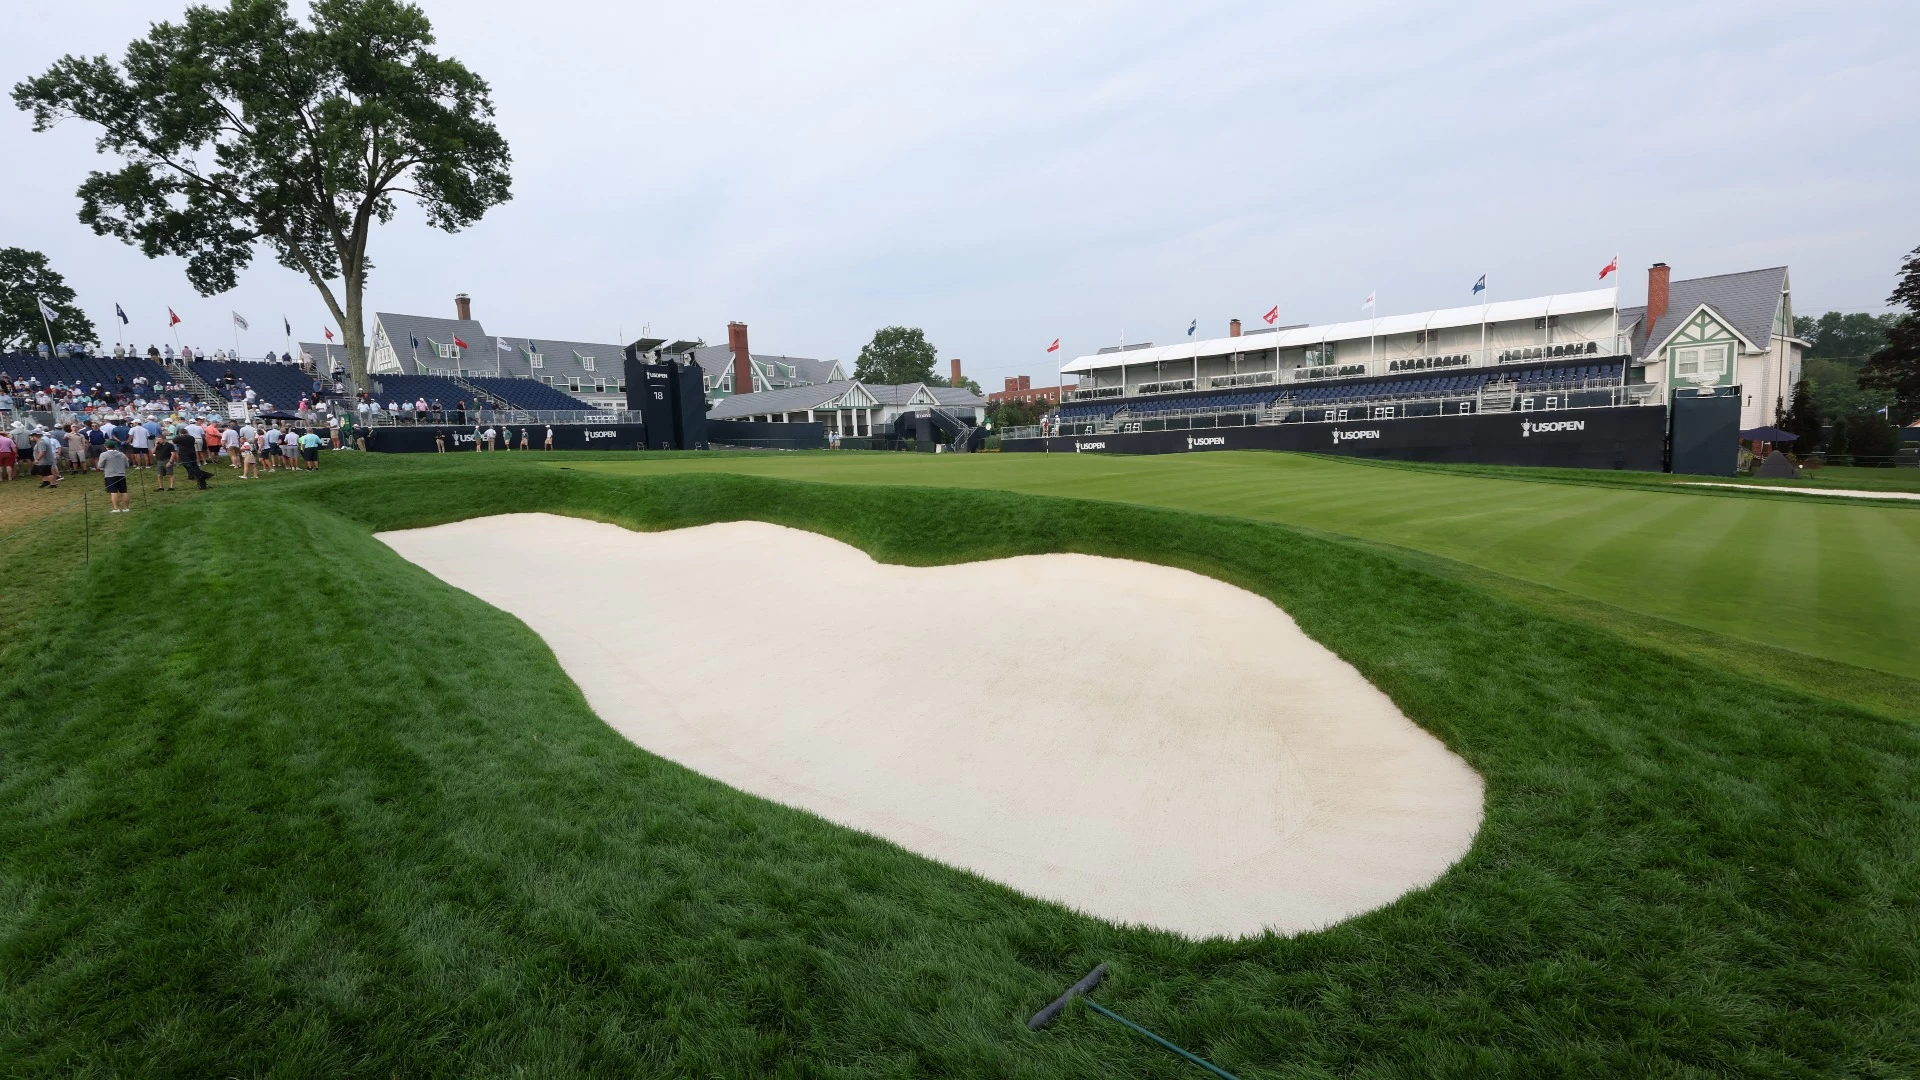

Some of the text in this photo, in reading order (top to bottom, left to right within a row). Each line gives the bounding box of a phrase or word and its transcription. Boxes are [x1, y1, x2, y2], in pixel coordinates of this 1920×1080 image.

[654, 391, 664, 400] 18
[1532, 420, 1585, 433] USOPEN
[590, 430, 617, 439] USOPEN
[1340, 430, 1380, 440] USOPEN
[1080, 441, 1106, 450] USOPEN
[1193, 437, 1225, 446] USOPEN
